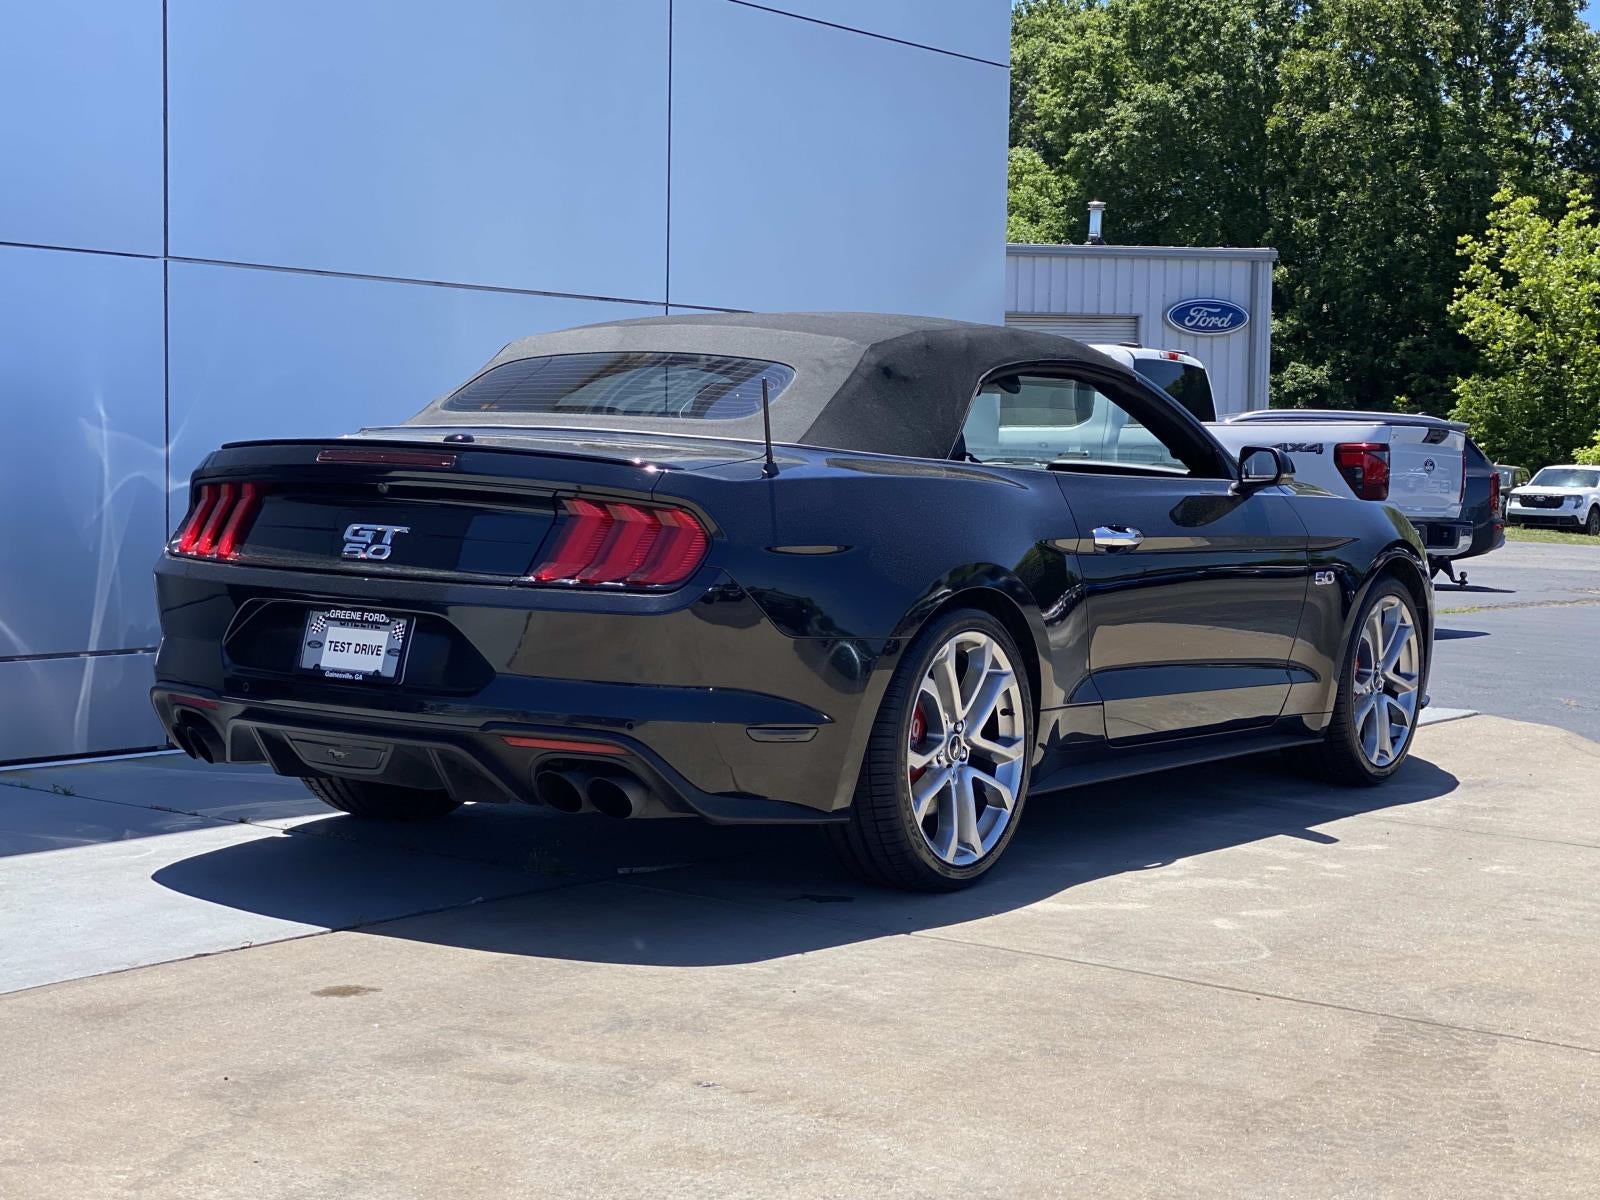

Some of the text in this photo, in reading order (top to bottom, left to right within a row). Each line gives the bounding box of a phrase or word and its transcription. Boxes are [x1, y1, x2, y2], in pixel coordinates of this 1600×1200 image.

[1184, 306, 1233, 327] Ford
[343, 523, 410, 545] GT
[329, 609, 386, 623] GREENE FORD
[328, 640, 352, 653] TEST
[354, 643, 383, 656] DRIVE
